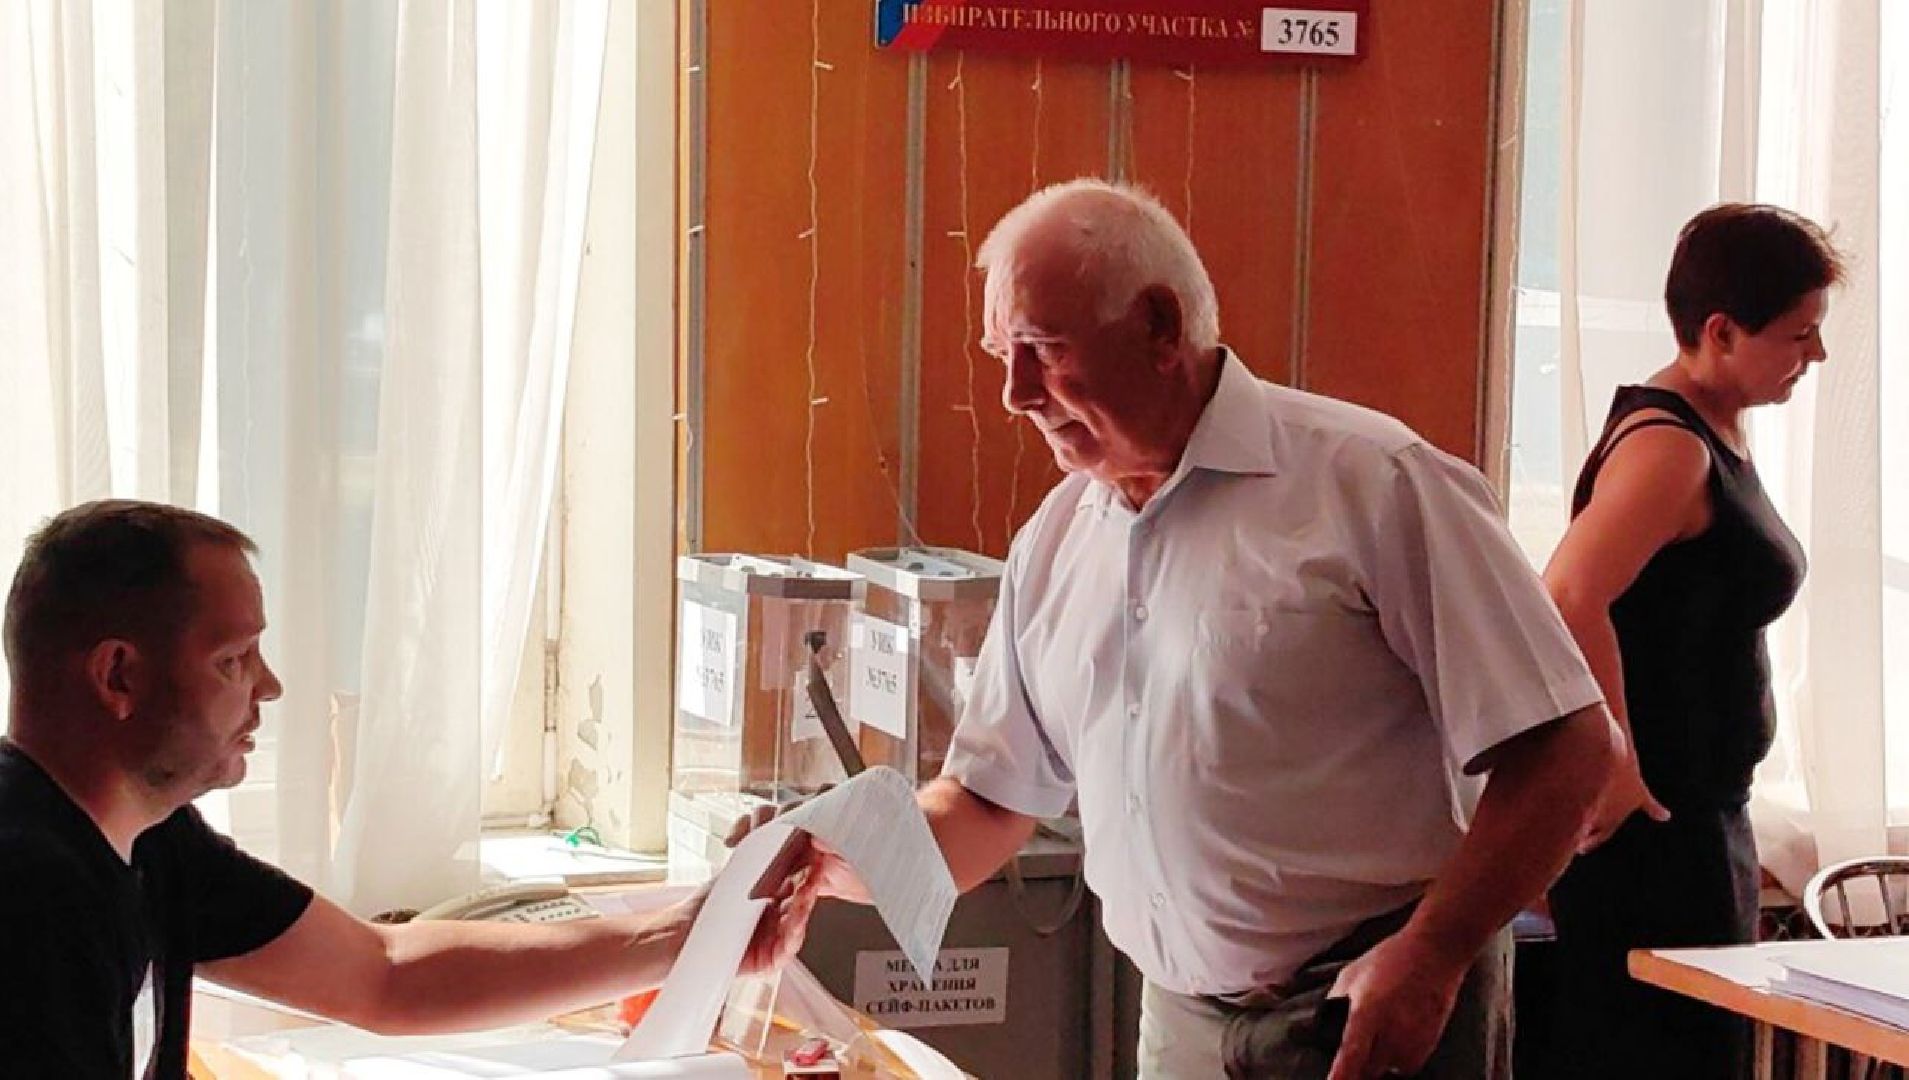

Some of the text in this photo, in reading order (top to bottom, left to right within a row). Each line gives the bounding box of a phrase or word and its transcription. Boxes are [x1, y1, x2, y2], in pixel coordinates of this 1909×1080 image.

[902, 3, 1121, 33] ИЗБИРАТЕЛЬНОГО
[1126, 12, 1229, 39] УЧАСТКА
[1277, 17, 1341, 47] 3765
[887, 958, 980, 972] МЕА ДЛЯ
[866, 998, 996, 1014] СЕЙФ-ПАКЕТОВ
